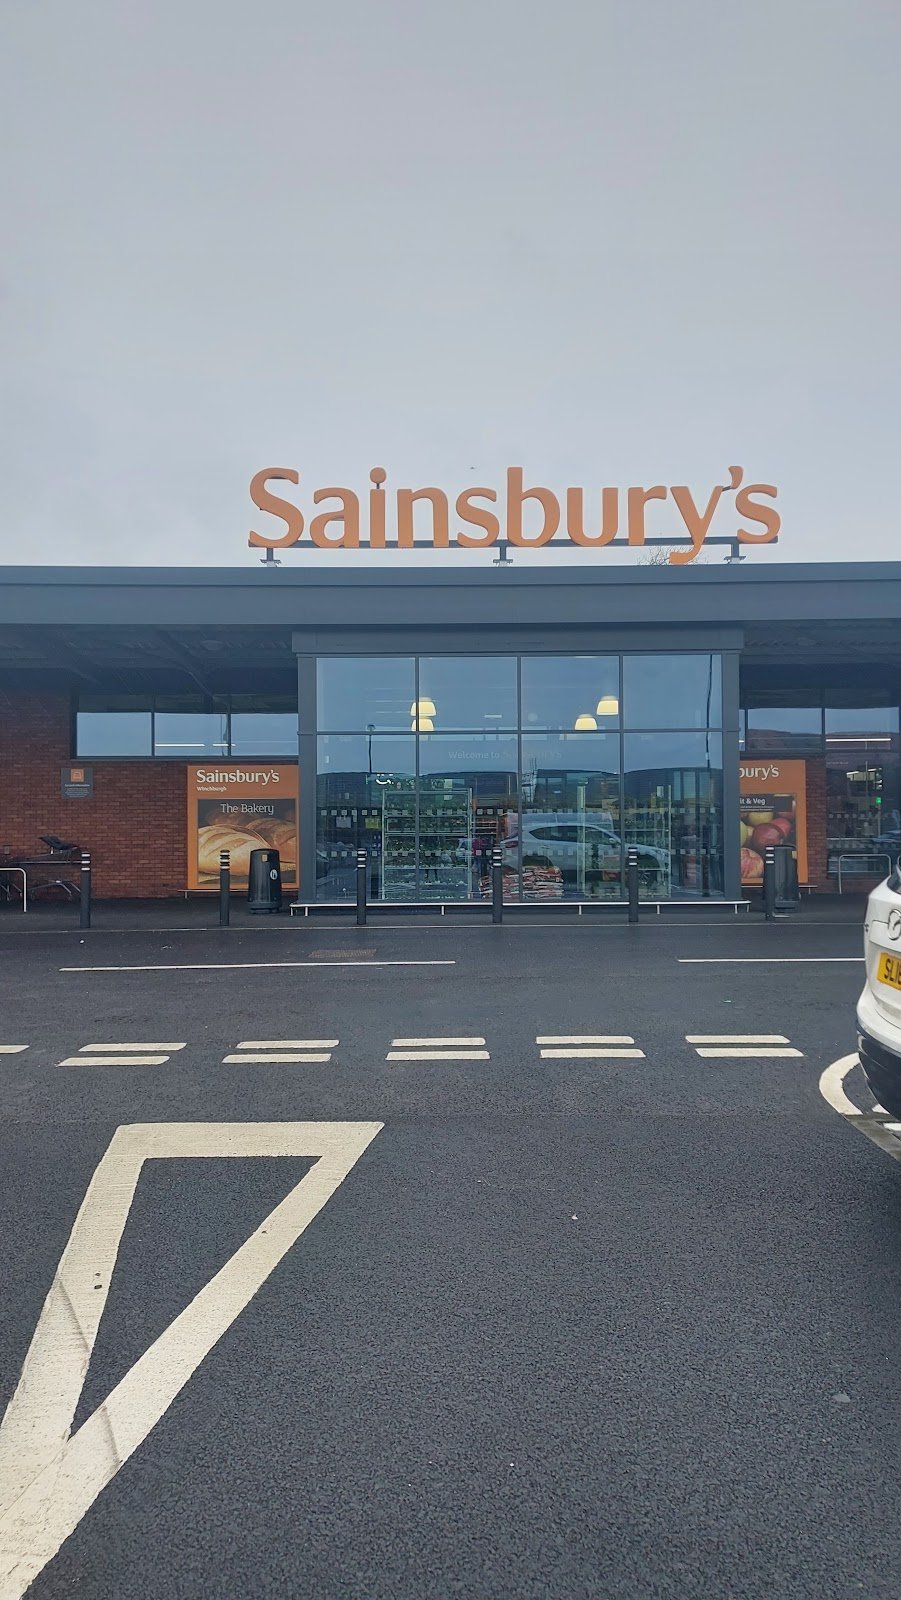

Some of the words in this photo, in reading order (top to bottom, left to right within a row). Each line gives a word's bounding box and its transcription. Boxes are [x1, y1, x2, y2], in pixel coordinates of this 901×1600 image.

[249, 466, 781, 564] Sainsbury's
[448, 750, 489, 759] Welcome
[491, 751, 500, 759] to
[196, 769, 280, 785] Sainsbury's
[753, 797, 766, 806] Veg
[220, 803, 239, 814] The
[240, 803, 274, 815] Bakery
